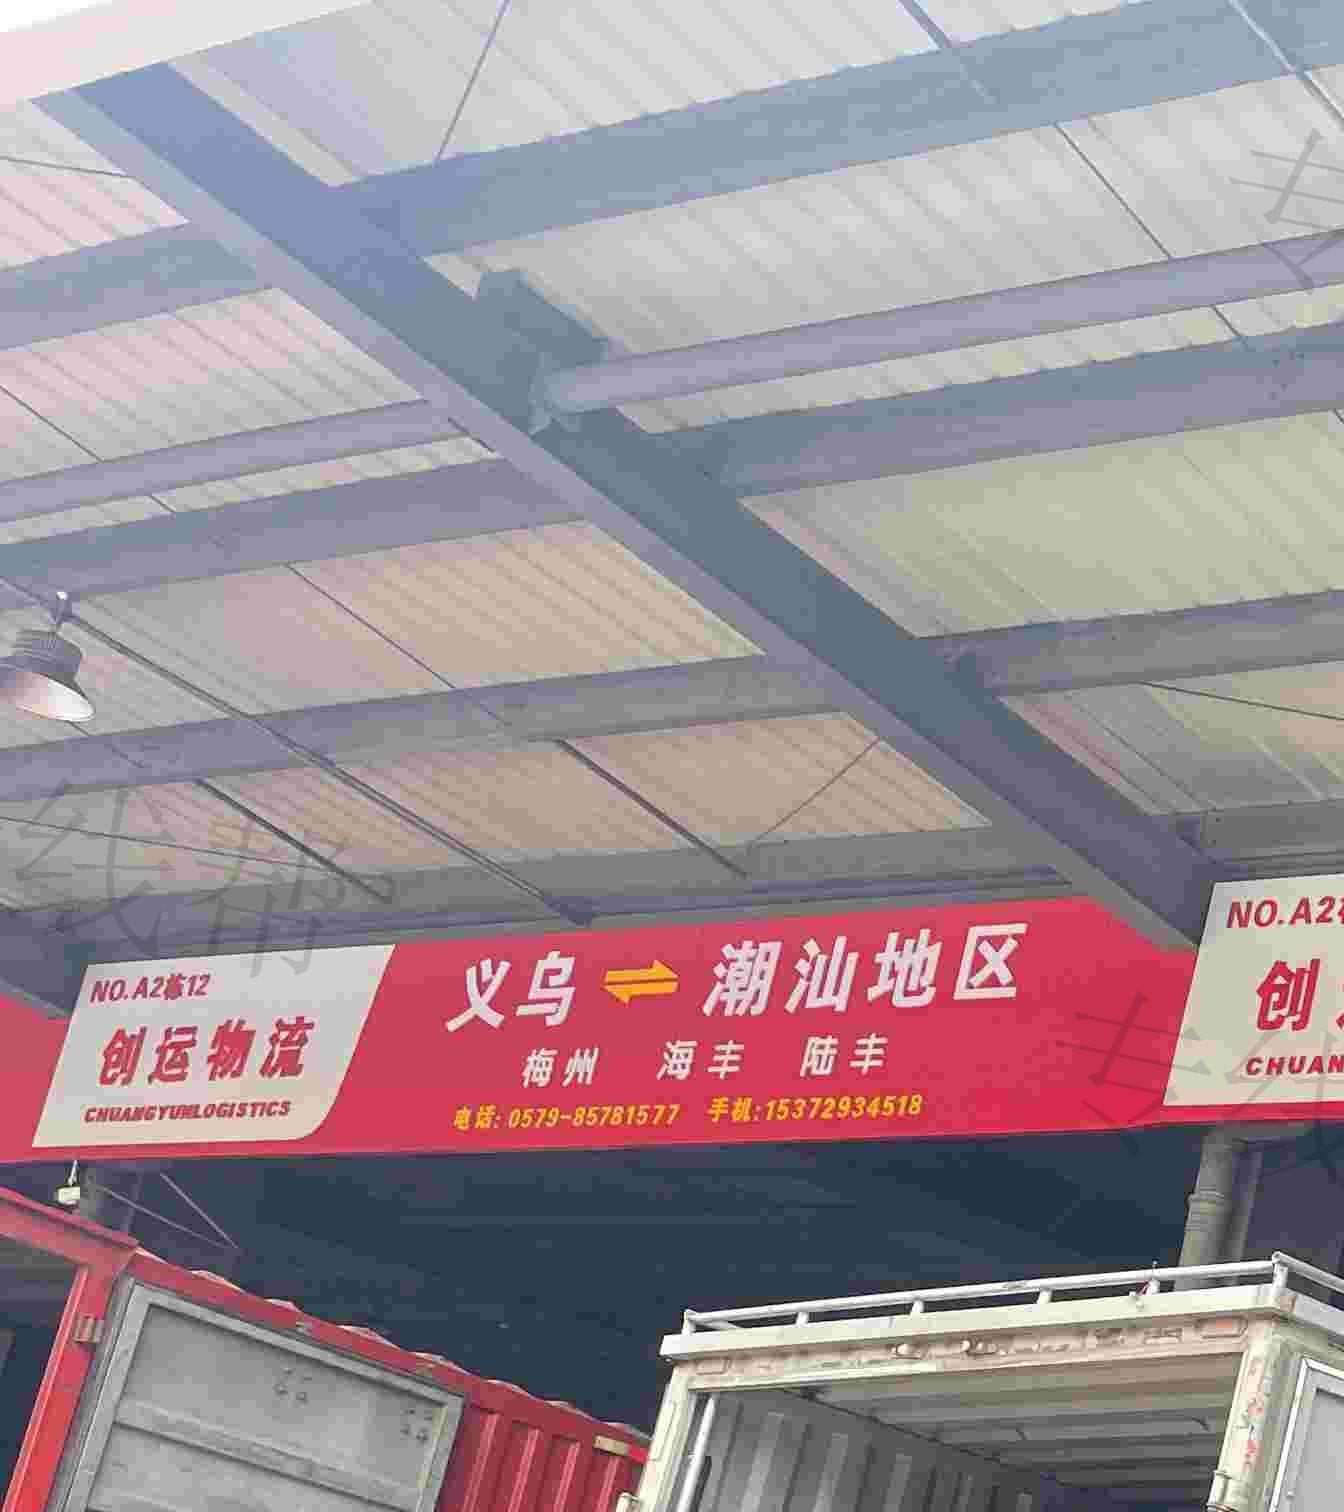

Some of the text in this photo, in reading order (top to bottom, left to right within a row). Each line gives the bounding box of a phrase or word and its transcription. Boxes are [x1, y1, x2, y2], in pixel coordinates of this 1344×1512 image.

[444, 922, 1029, 1033] 义乌 潮汕地区
[97, 1016, 316, 1086] 创运物流
[521, 1035, 888, 1088] 梅州 海丰 陆丰
[83, 1098, 293, 1125] CHUANGYUNLOGISTICS
[508, 1099, 680, 1129] 0579-85781577
